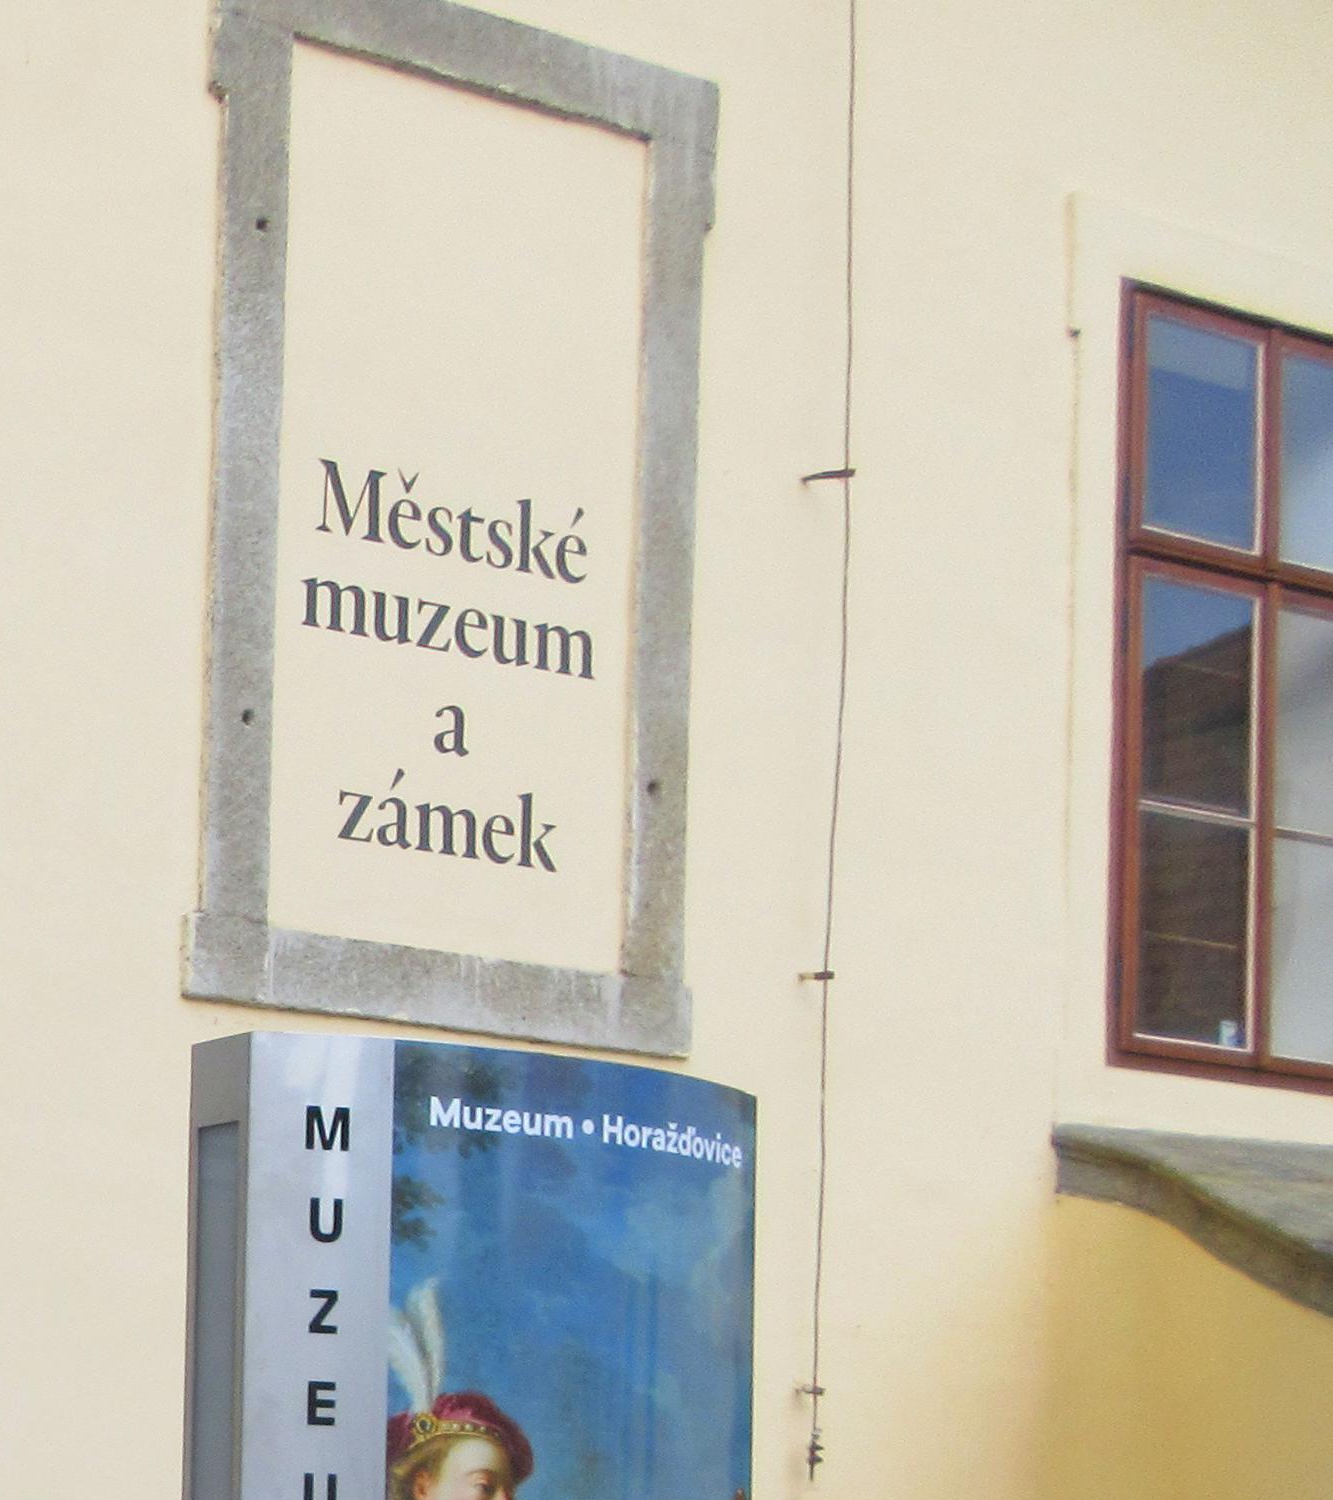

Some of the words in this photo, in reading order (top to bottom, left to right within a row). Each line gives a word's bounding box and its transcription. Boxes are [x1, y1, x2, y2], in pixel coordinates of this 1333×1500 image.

[316, 458, 588, 584] Městské
[301, 577, 595, 680] muzeum
[433, 704, 469, 757] a
[338, 768, 558, 873] zámek
[430, 1095, 572, 1139] Muzeum
[602, 1114, 742, 1168] Horažďovice
